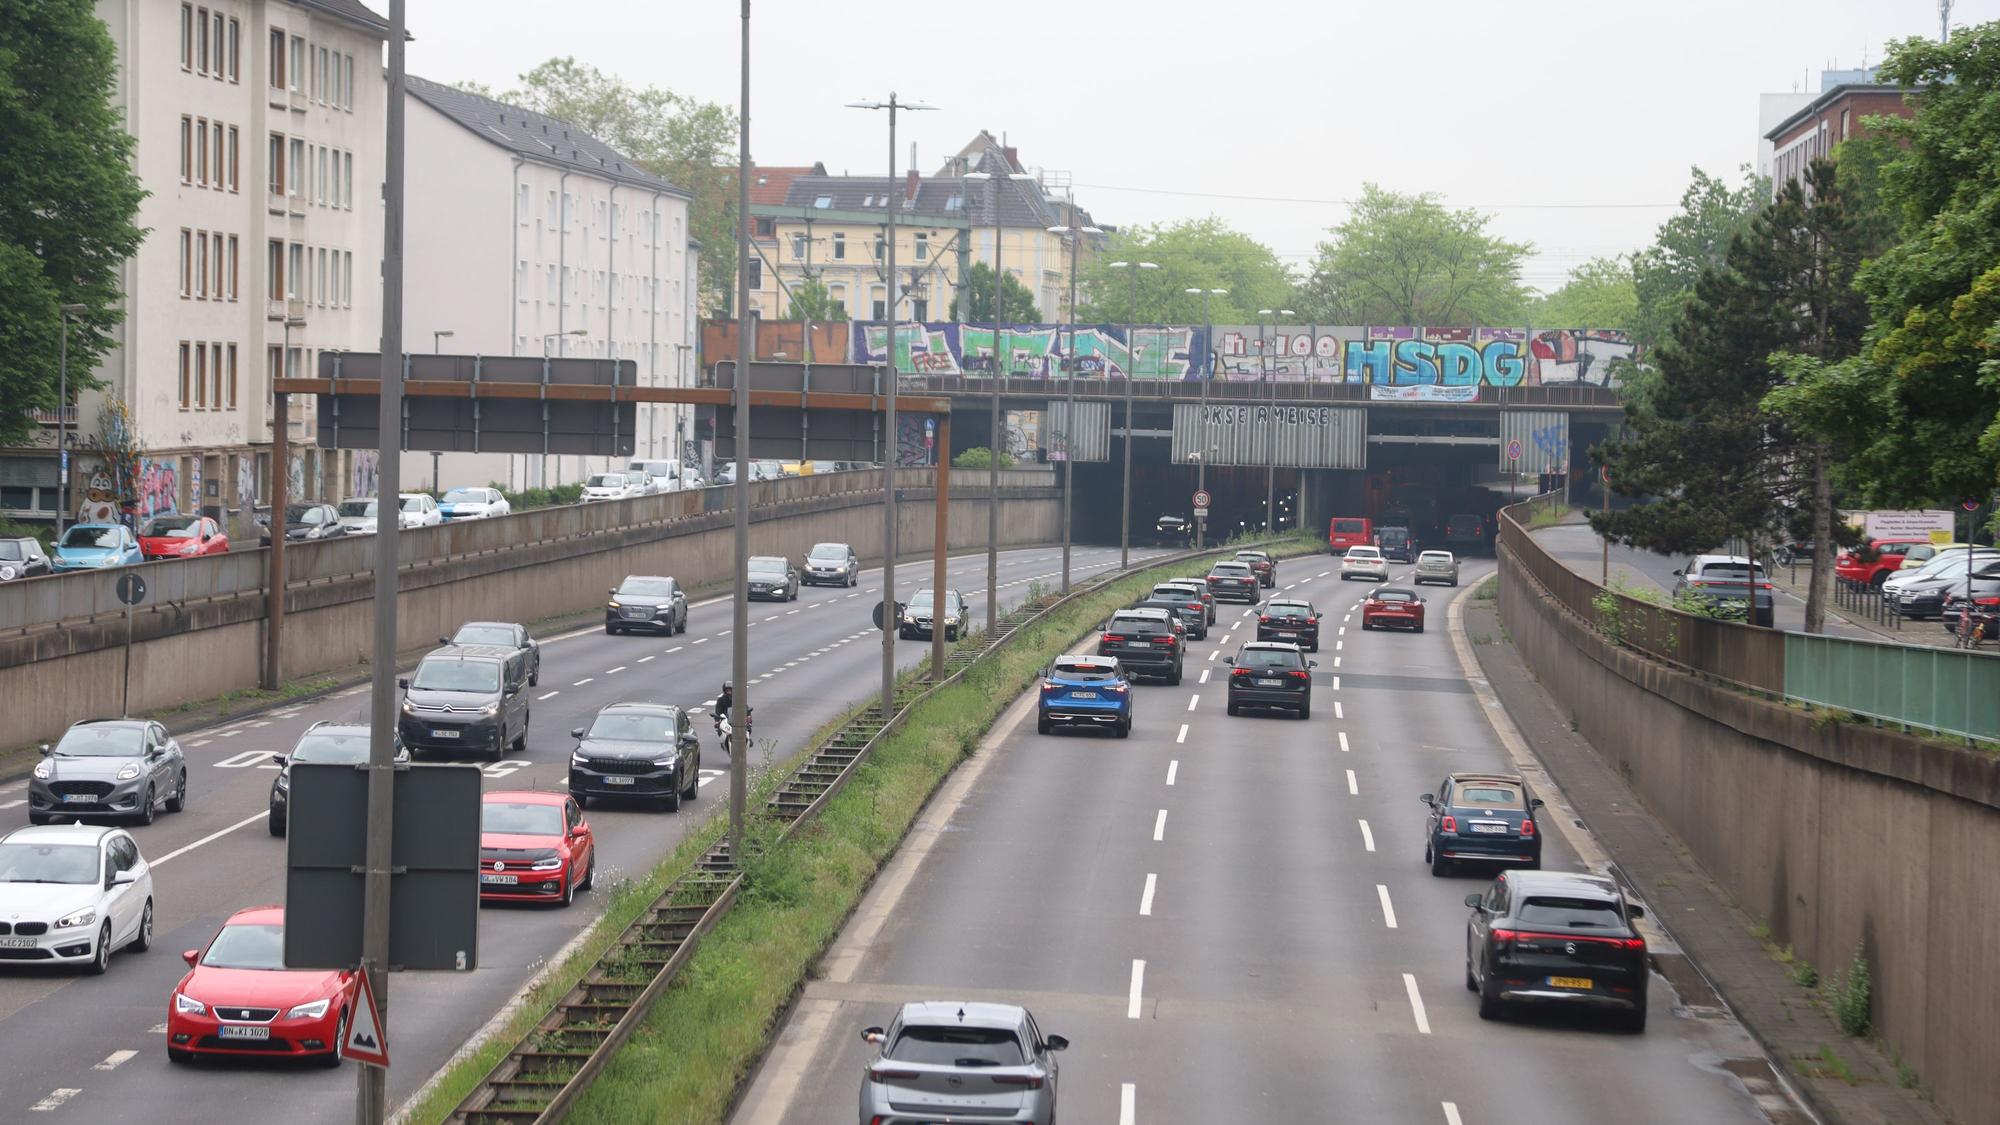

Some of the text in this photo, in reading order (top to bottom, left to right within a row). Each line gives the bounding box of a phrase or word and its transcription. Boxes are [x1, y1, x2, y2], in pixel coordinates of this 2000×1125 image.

[1345, 340, 1526, 386] HSDG
[1197, 495, 1206, 503] 50
[224, 1026, 233, 1035] BN
[238, 1027, 247, 1036] KI
